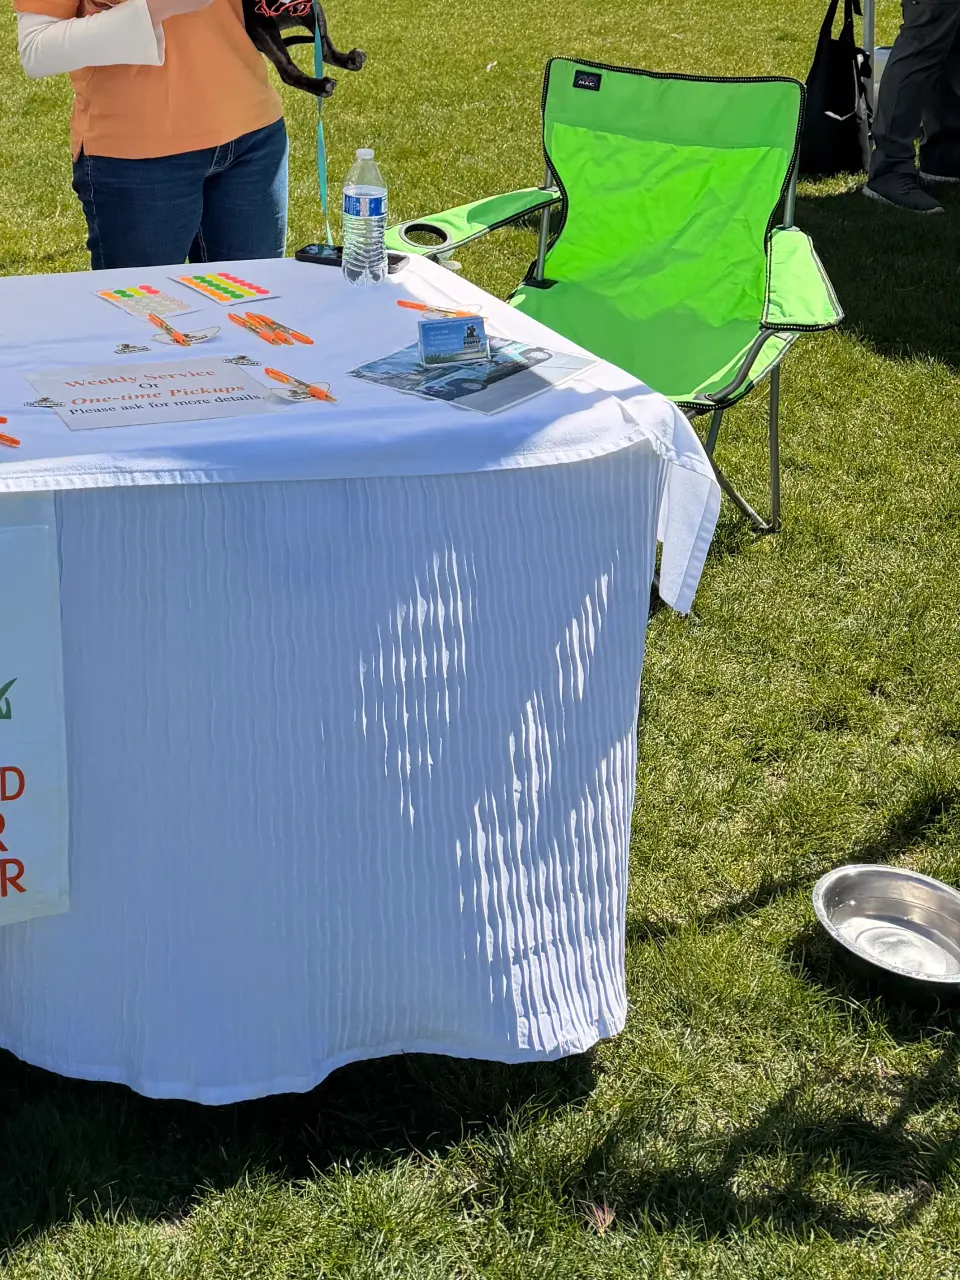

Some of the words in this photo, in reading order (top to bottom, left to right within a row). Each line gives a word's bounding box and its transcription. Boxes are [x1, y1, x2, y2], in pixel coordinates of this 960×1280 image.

[64, 375, 138, 388] Weekly
[144, 369, 216, 381] Service
[69, 405, 117, 416] Please
[121, 402, 144, 411] ask
[148, 400, 169, 408] for
[174, 398, 211, 406] more
[214, 393, 266, 404] details.
[71, 391, 162, 406] One-time
[169, 384, 245, 397] Pickups
